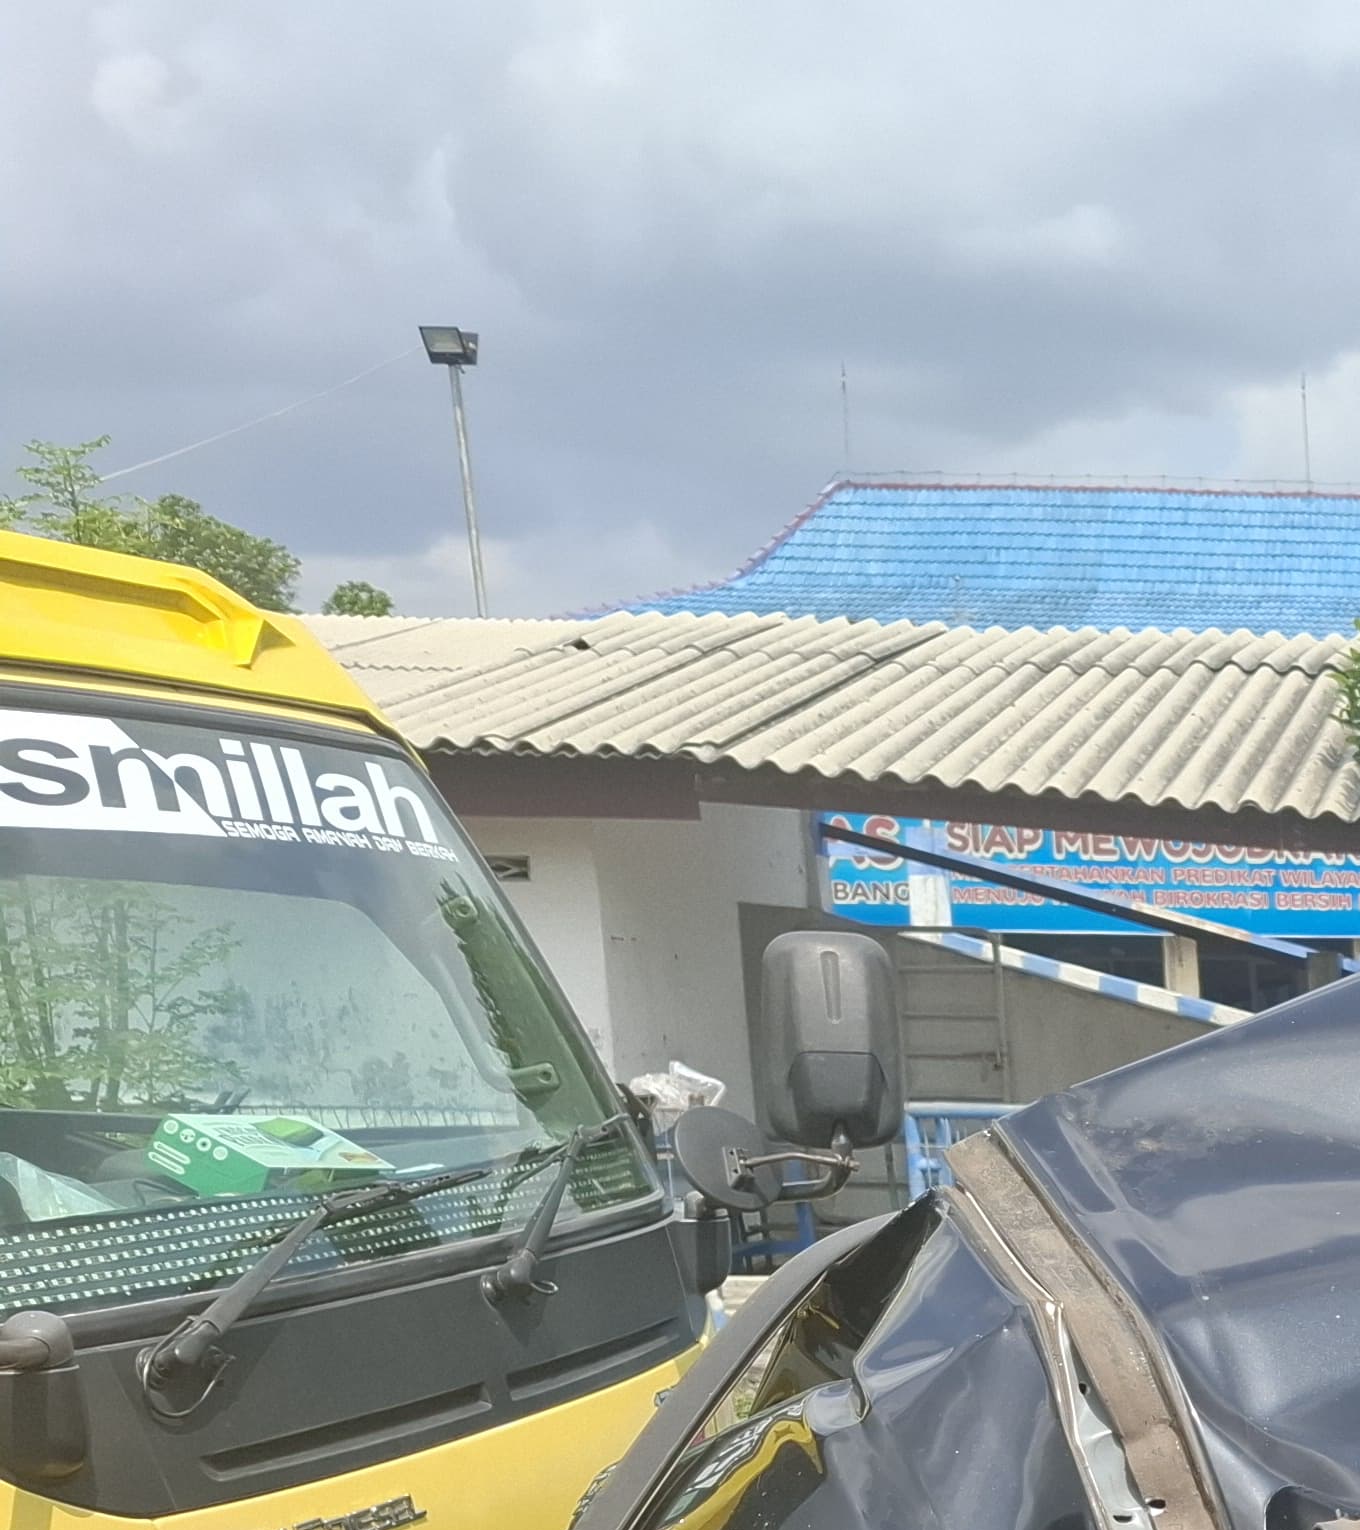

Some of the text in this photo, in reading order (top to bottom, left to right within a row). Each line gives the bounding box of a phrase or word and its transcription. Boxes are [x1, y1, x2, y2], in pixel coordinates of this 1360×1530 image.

[221, 820, 301, 842] SEMOGA
[945, 820, 1043, 859] SIAP
[1172, 868, 1276, 888] PREDIKAT
[1153, 890, 1269, 909] BIROKRASI
[1275, 892, 1352, 911] BERSIH
